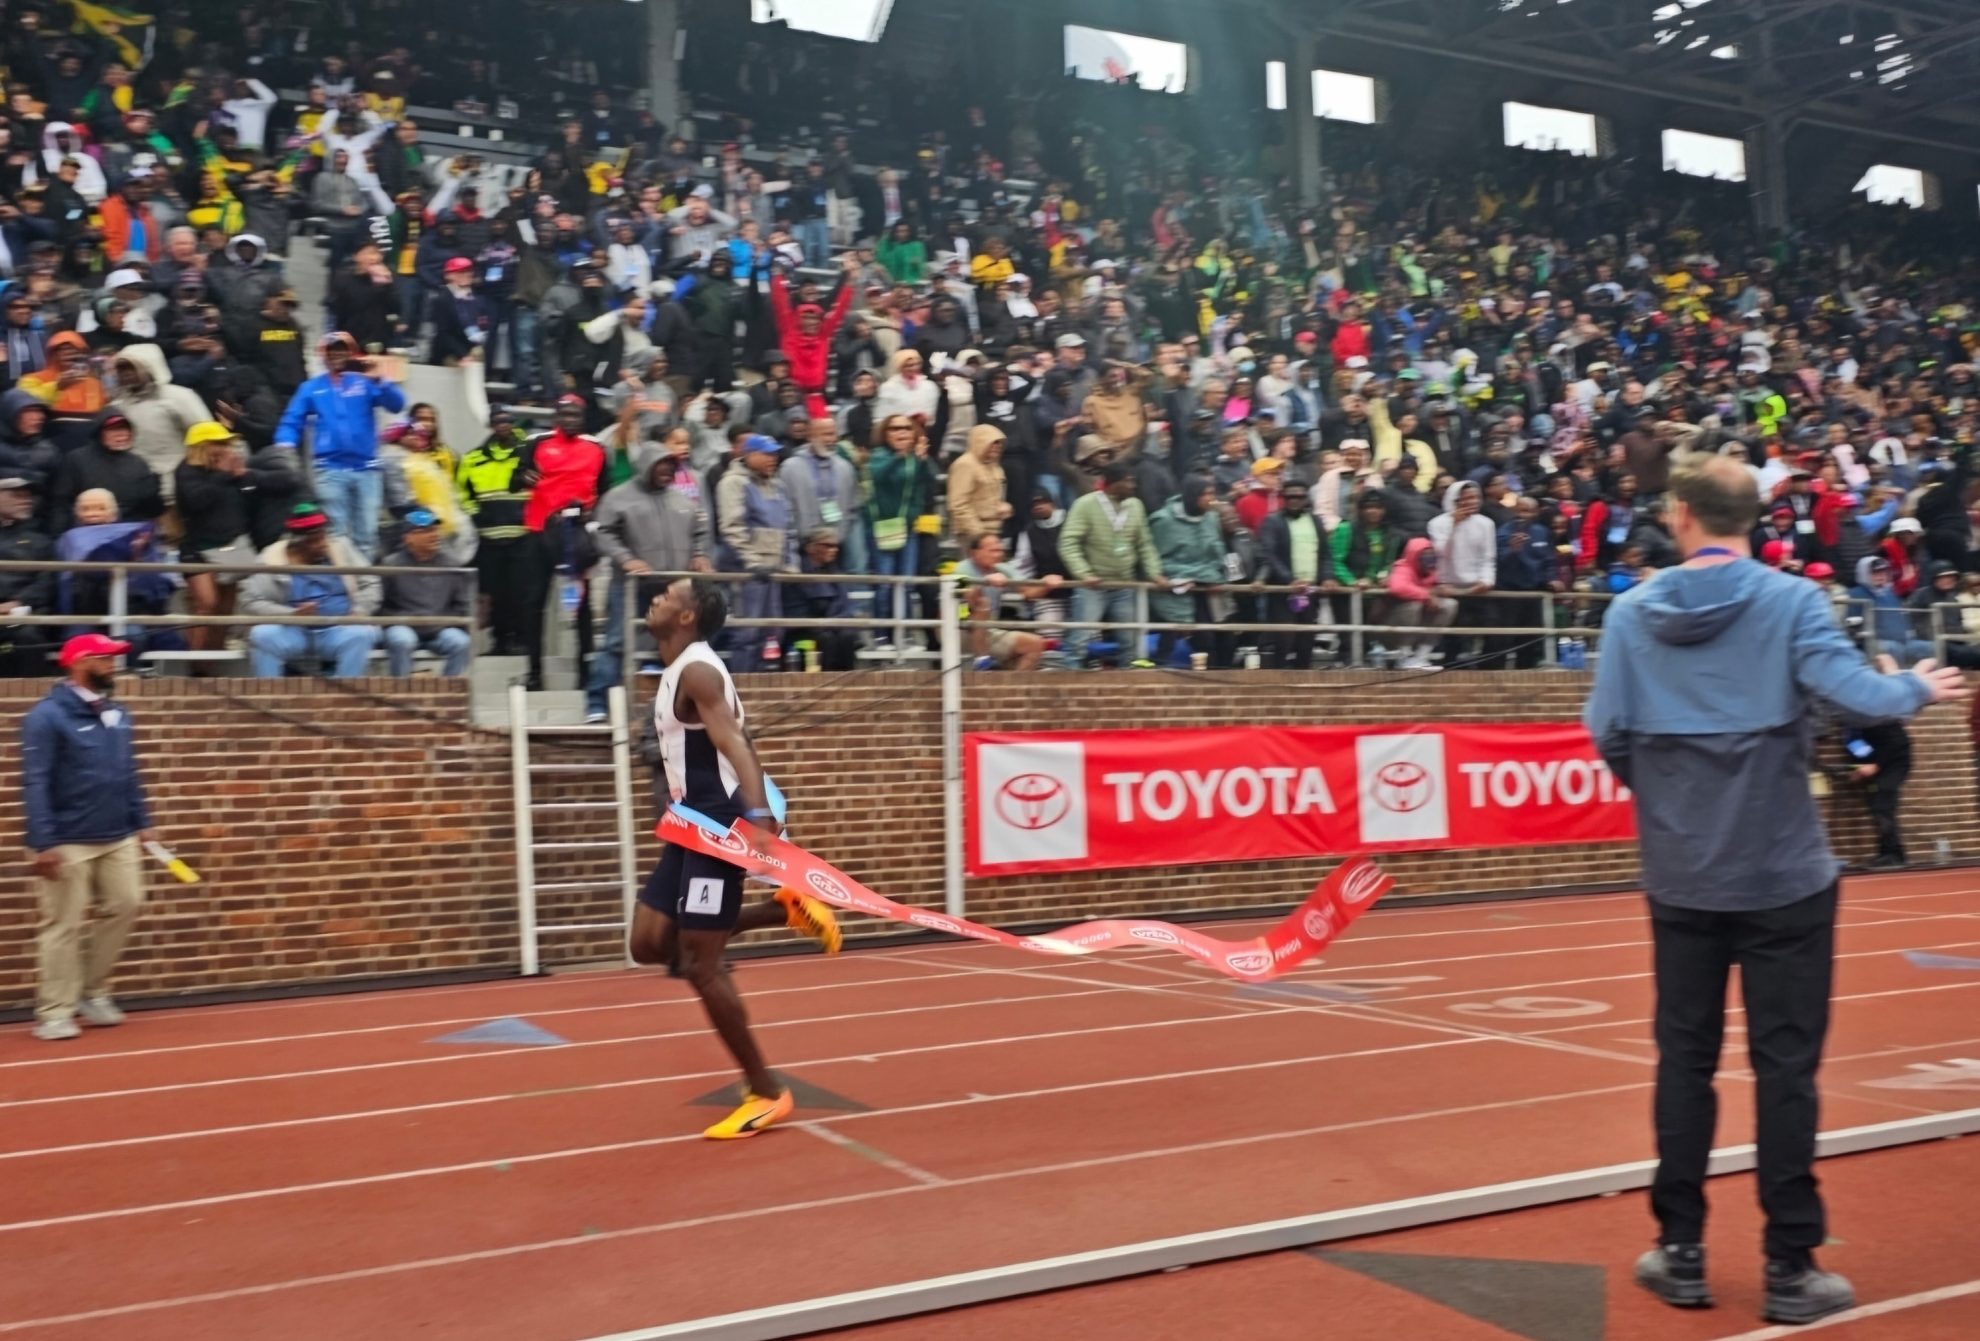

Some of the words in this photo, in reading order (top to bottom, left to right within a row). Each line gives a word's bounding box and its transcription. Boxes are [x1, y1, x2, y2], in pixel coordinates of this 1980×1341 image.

[1102, 766, 1338, 823] TOYOTA
[699, 884, 709, 904] A
[1446, 996, 1613, 1019] 6
